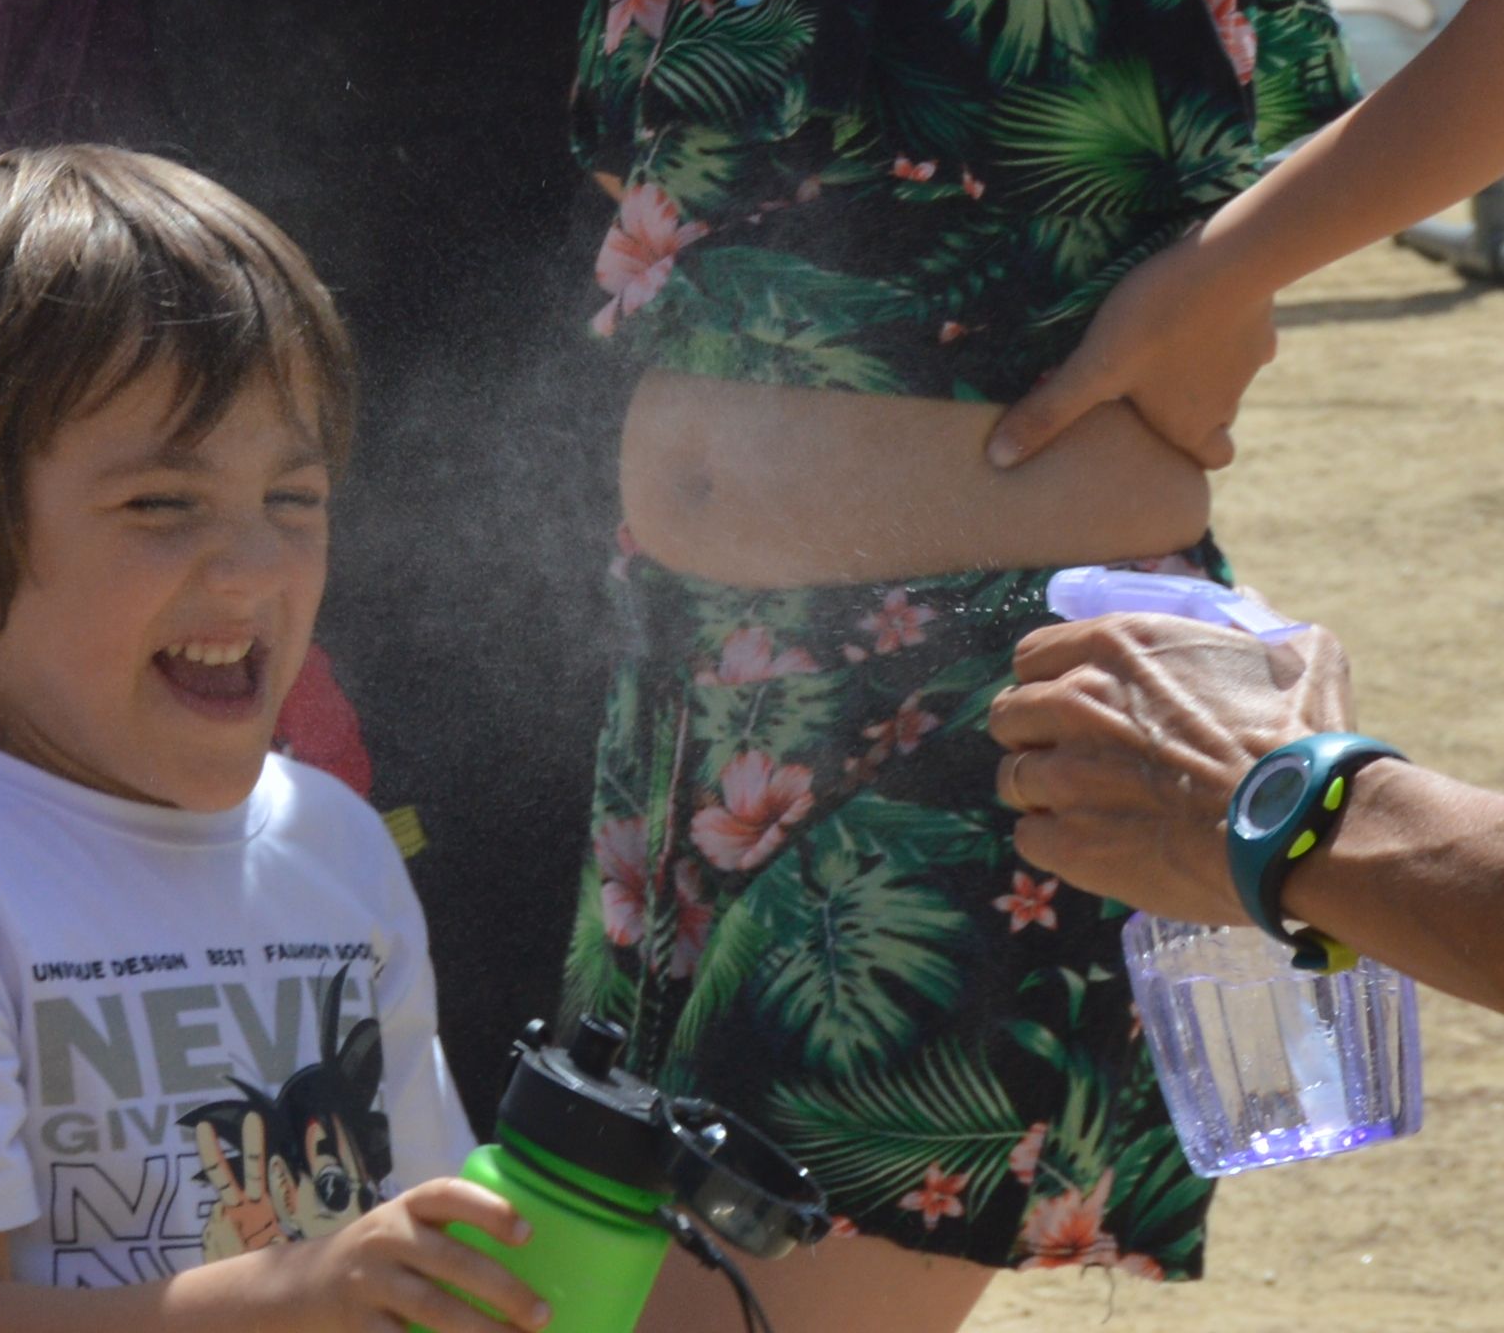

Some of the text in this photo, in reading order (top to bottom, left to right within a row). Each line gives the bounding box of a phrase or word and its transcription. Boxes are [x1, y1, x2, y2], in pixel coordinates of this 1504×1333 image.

[32, 957, 107, 984] UNIQUE
[109, 950, 188, 978] DESIGN
[206, 947, 246, 967] BEST
